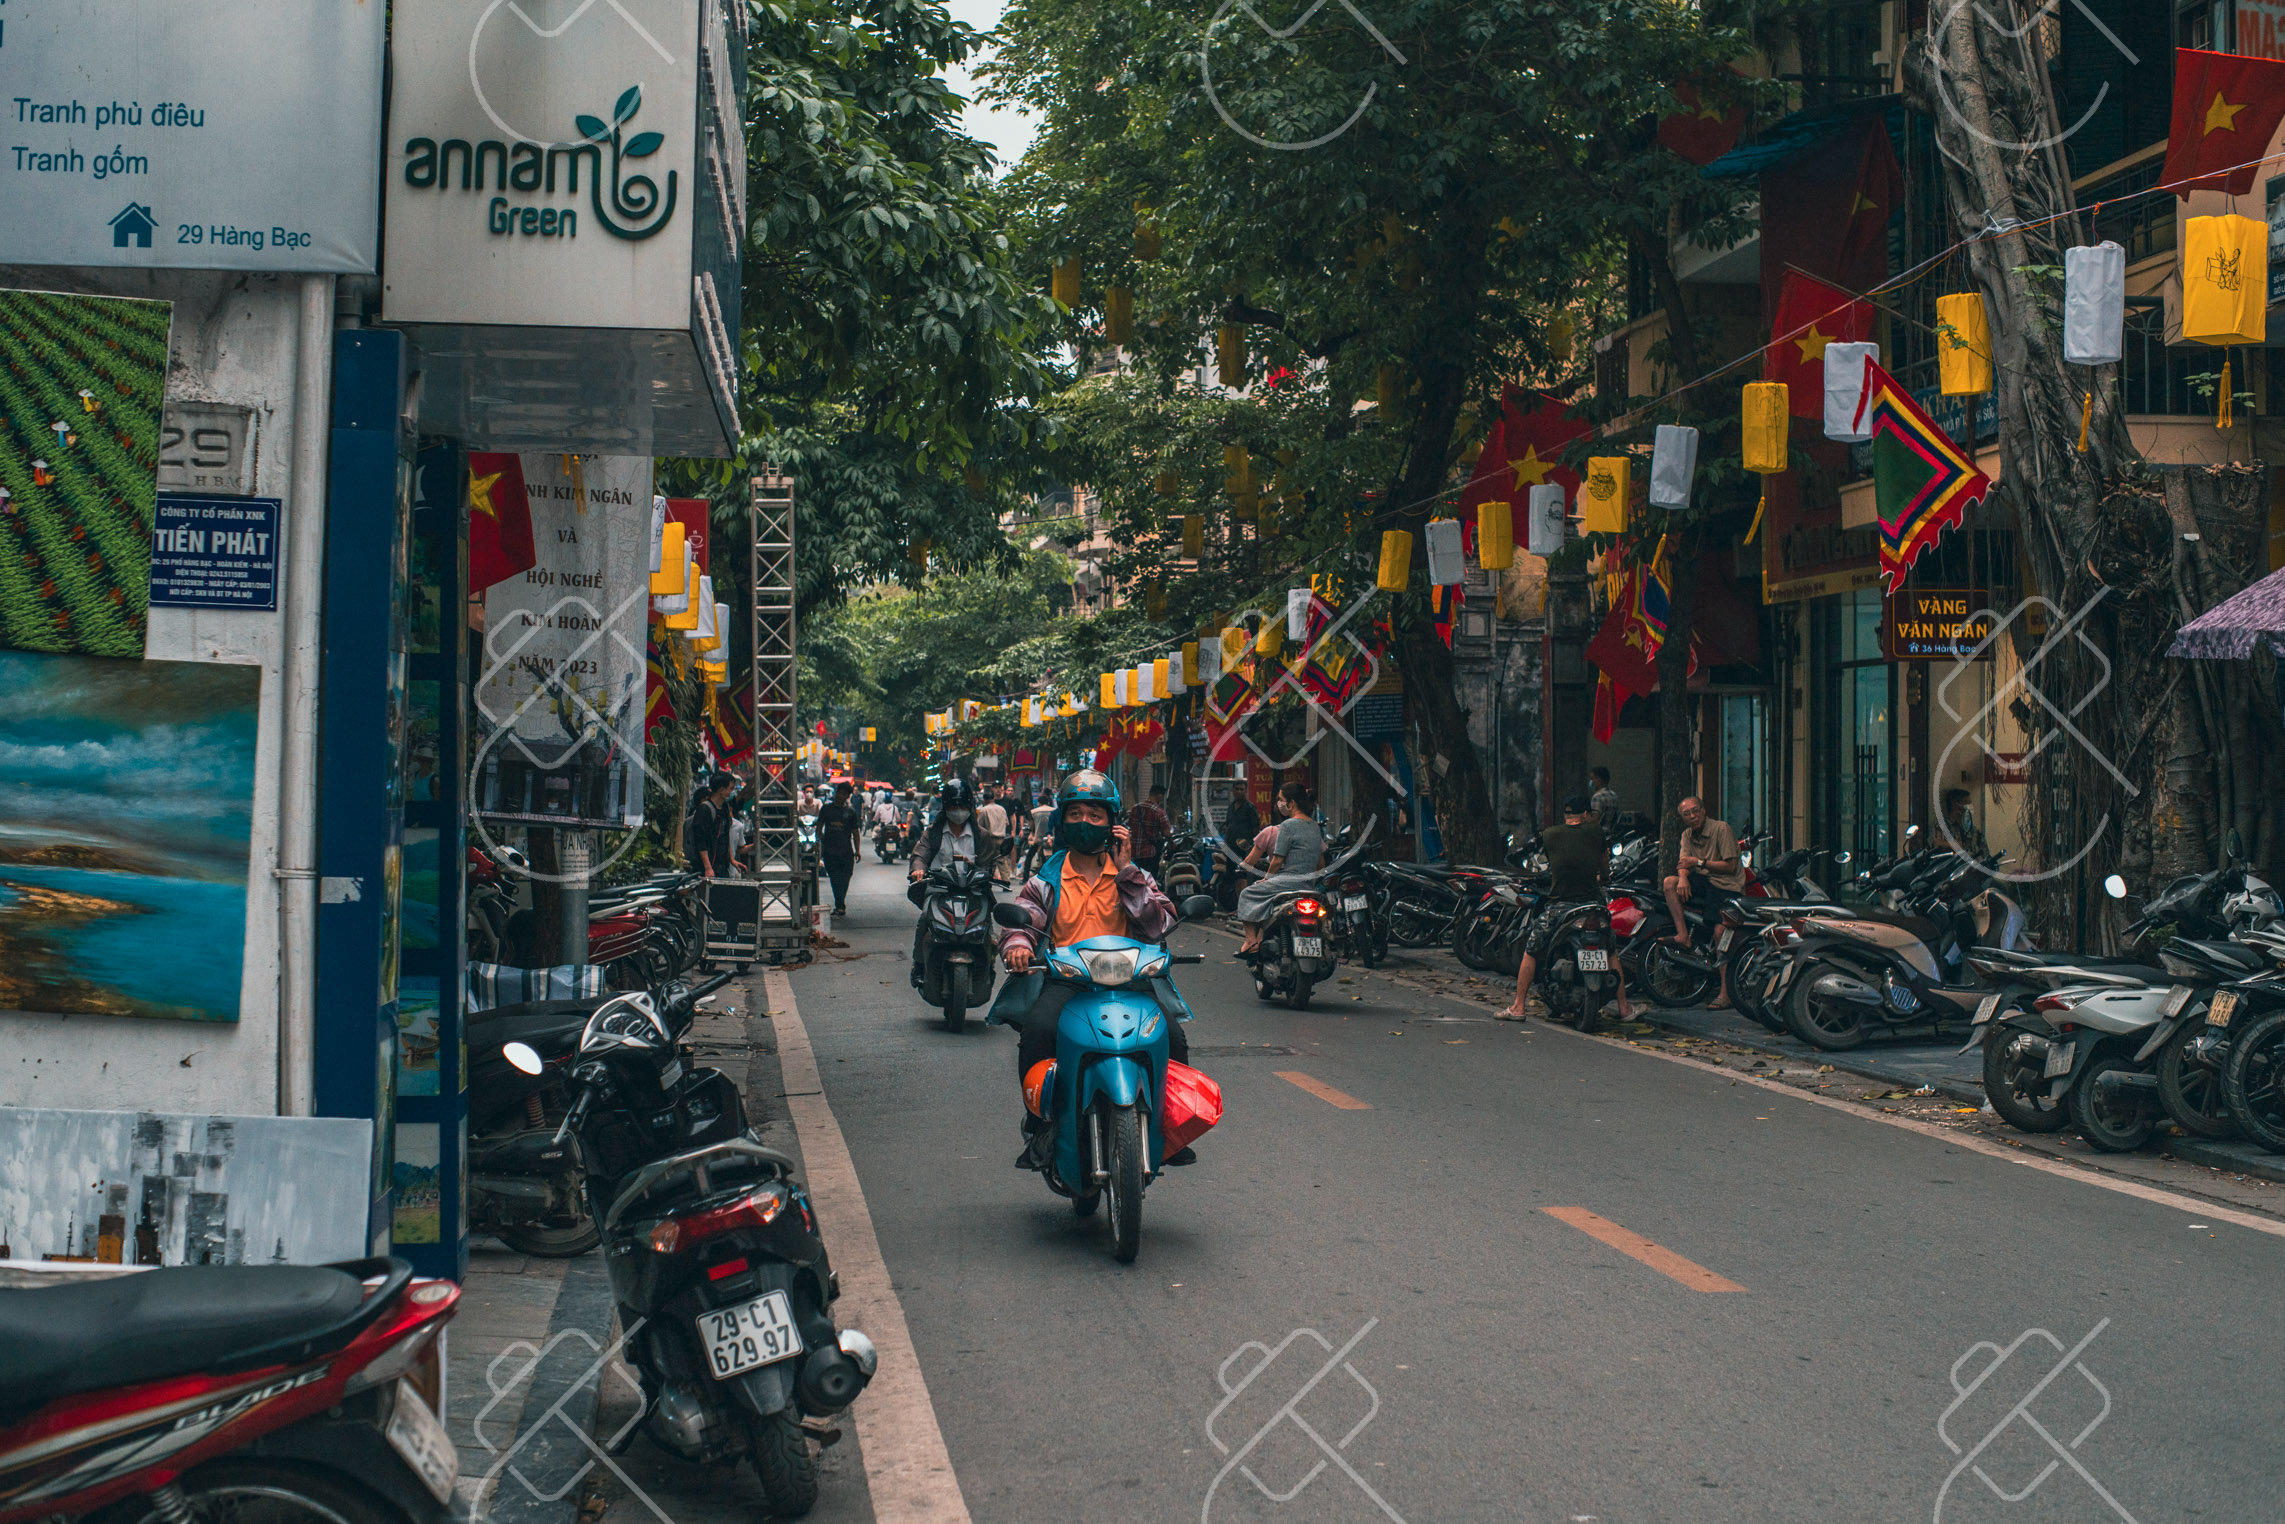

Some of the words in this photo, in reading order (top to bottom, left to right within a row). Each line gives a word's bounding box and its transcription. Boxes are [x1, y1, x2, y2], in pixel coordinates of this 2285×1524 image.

[13, 97, 86, 124] Tranh
[95, 101, 142, 130] phù
[151, 102, 205, 127] điêu
[12, 146, 84, 173] Tranh
[93, 144, 148, 180] gốm
[489, 197, 577, 238] Green
[177, 224, 203, 244] 29
[210, 225, 264, 250] Hàng
[271, 227, 312, 250] Bạc
[162, 428, 232, 468] 29
[590, 487, 633, 506] NGÂN
[160, 506, 187, 518] CÔNG
[189, 508, 200, 518] TY
[245, 510, 266, 521] XNK
[155, 522, 205, 554] TIẾN
[211, 528, 270, 556] PHÁT
[558, 527, 578, 544] VÀ
[526, 567, 555, 586] HỘI
[560, 568, 603, 589] NGHỀ
[1918, 596, 1967, 615] VÀNG
[558, 613, 602, 631] HOÀN
[1922, 644, 1932, 653] 36
[1580, 960, 1607, 970] 757.23
[1582, 951, 1603, 961] 29-C1
[710, 1298, 779, 1343] 29-C1
[713, 1324, 791, 1374] 629.97
[172, 1365, 331, 1432] BLADE
